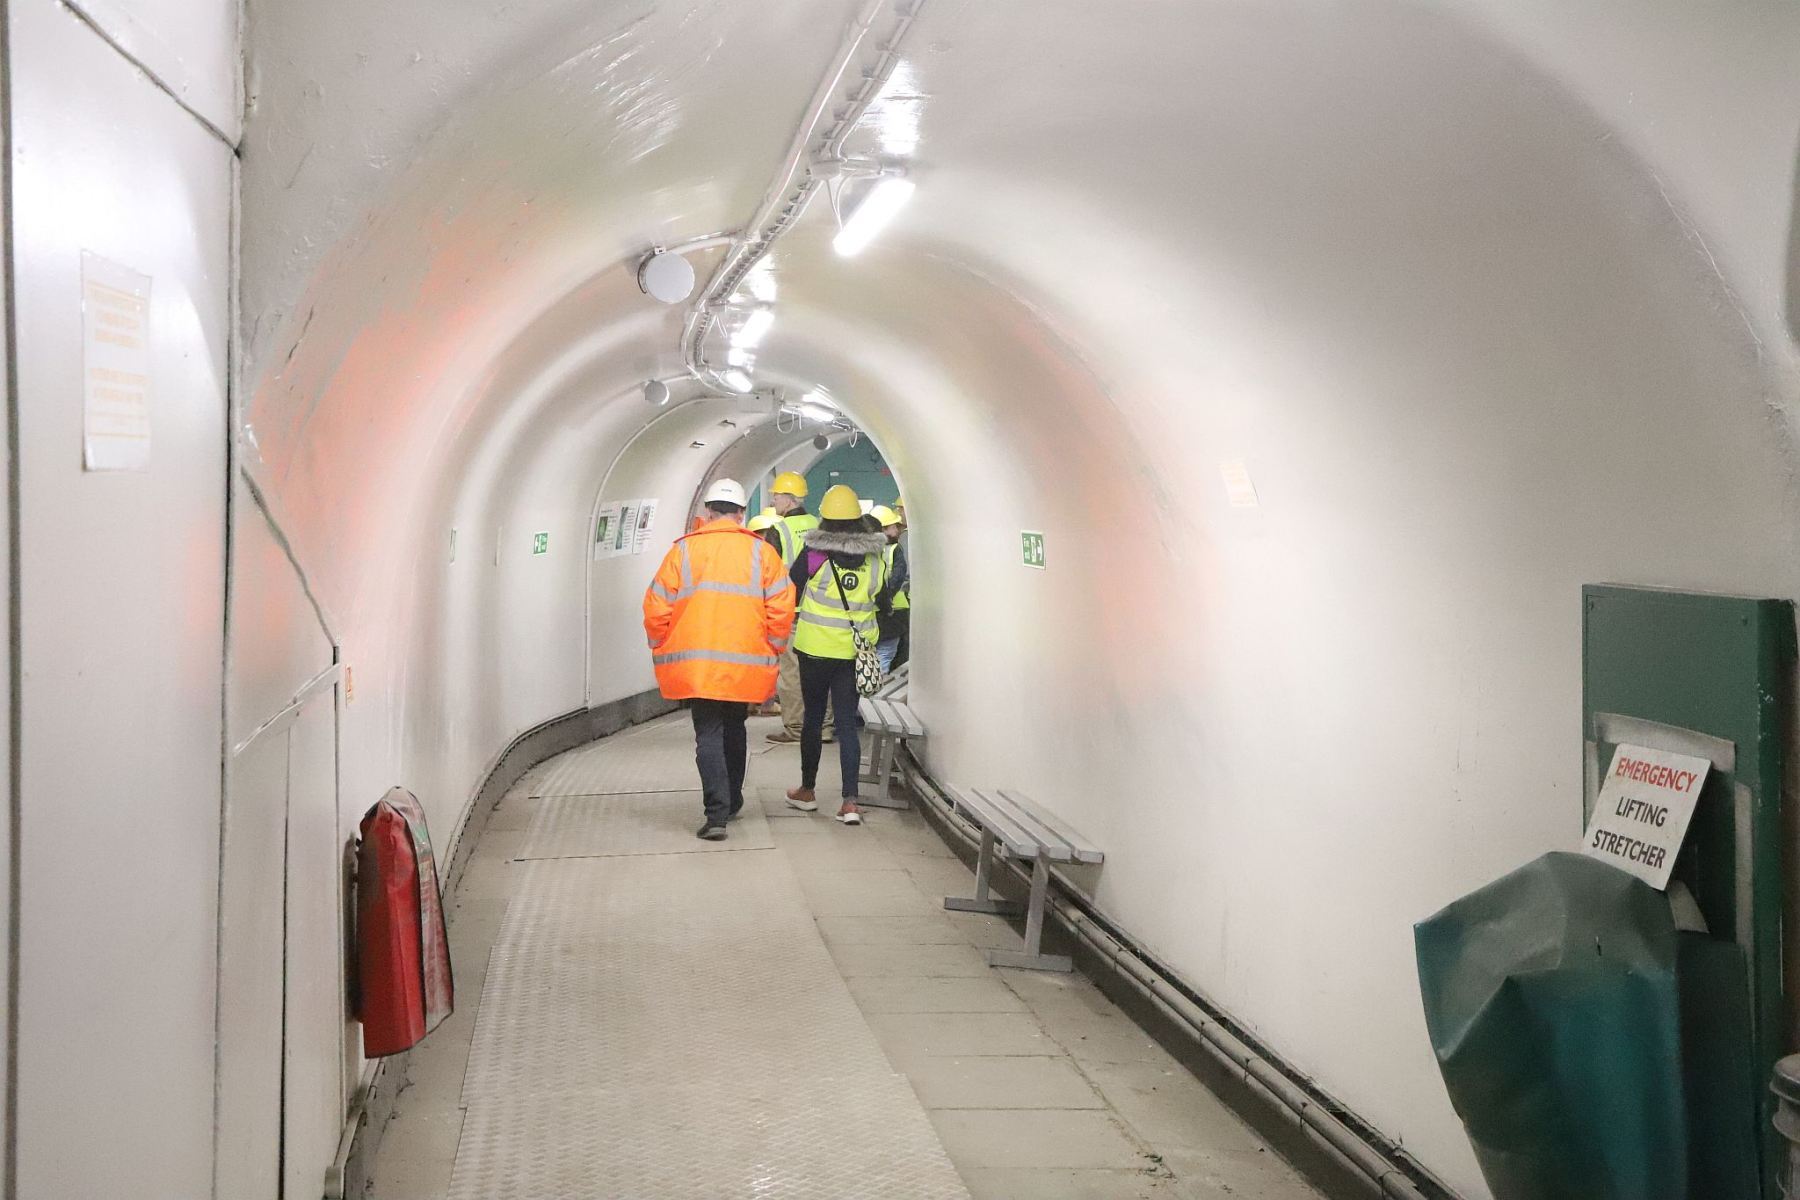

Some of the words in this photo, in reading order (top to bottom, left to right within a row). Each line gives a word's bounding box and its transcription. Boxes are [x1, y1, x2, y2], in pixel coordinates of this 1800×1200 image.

[1616, 758, 1697, 792] EMERGENCY
[1615, 796, 1668, 827] LIFTING
[1592, 829, 1667, 868] STRETCHER
